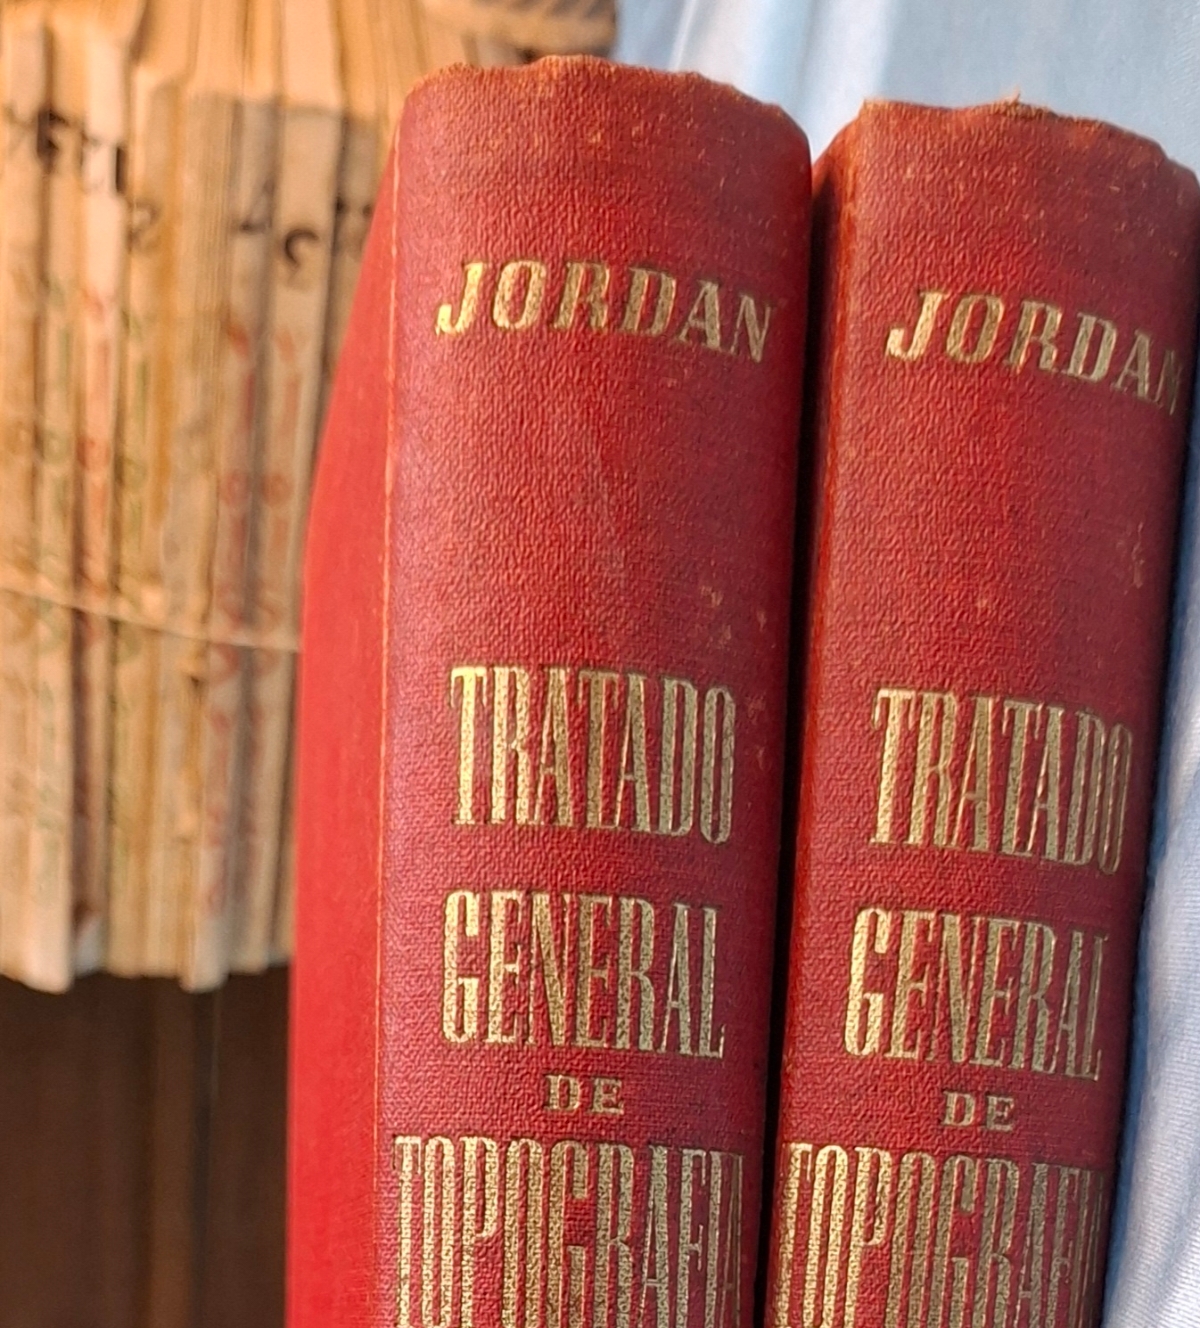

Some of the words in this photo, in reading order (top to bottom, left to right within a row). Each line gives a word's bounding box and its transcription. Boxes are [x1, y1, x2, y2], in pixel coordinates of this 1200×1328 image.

[435, 259, 776, 363] JORDAN
[886, 289, 1182, 416] JORDAN
[450, 665, 736, 845] TRATADO
[870, 687, 1133, 876] TRATADO
[441, 888, 726, 1059] GENERAL
[843, 907, 1108, 1082] GENERAL
[544, 1073, 625, 1115] DE
[942, 1090, 1014, 1132] DE
